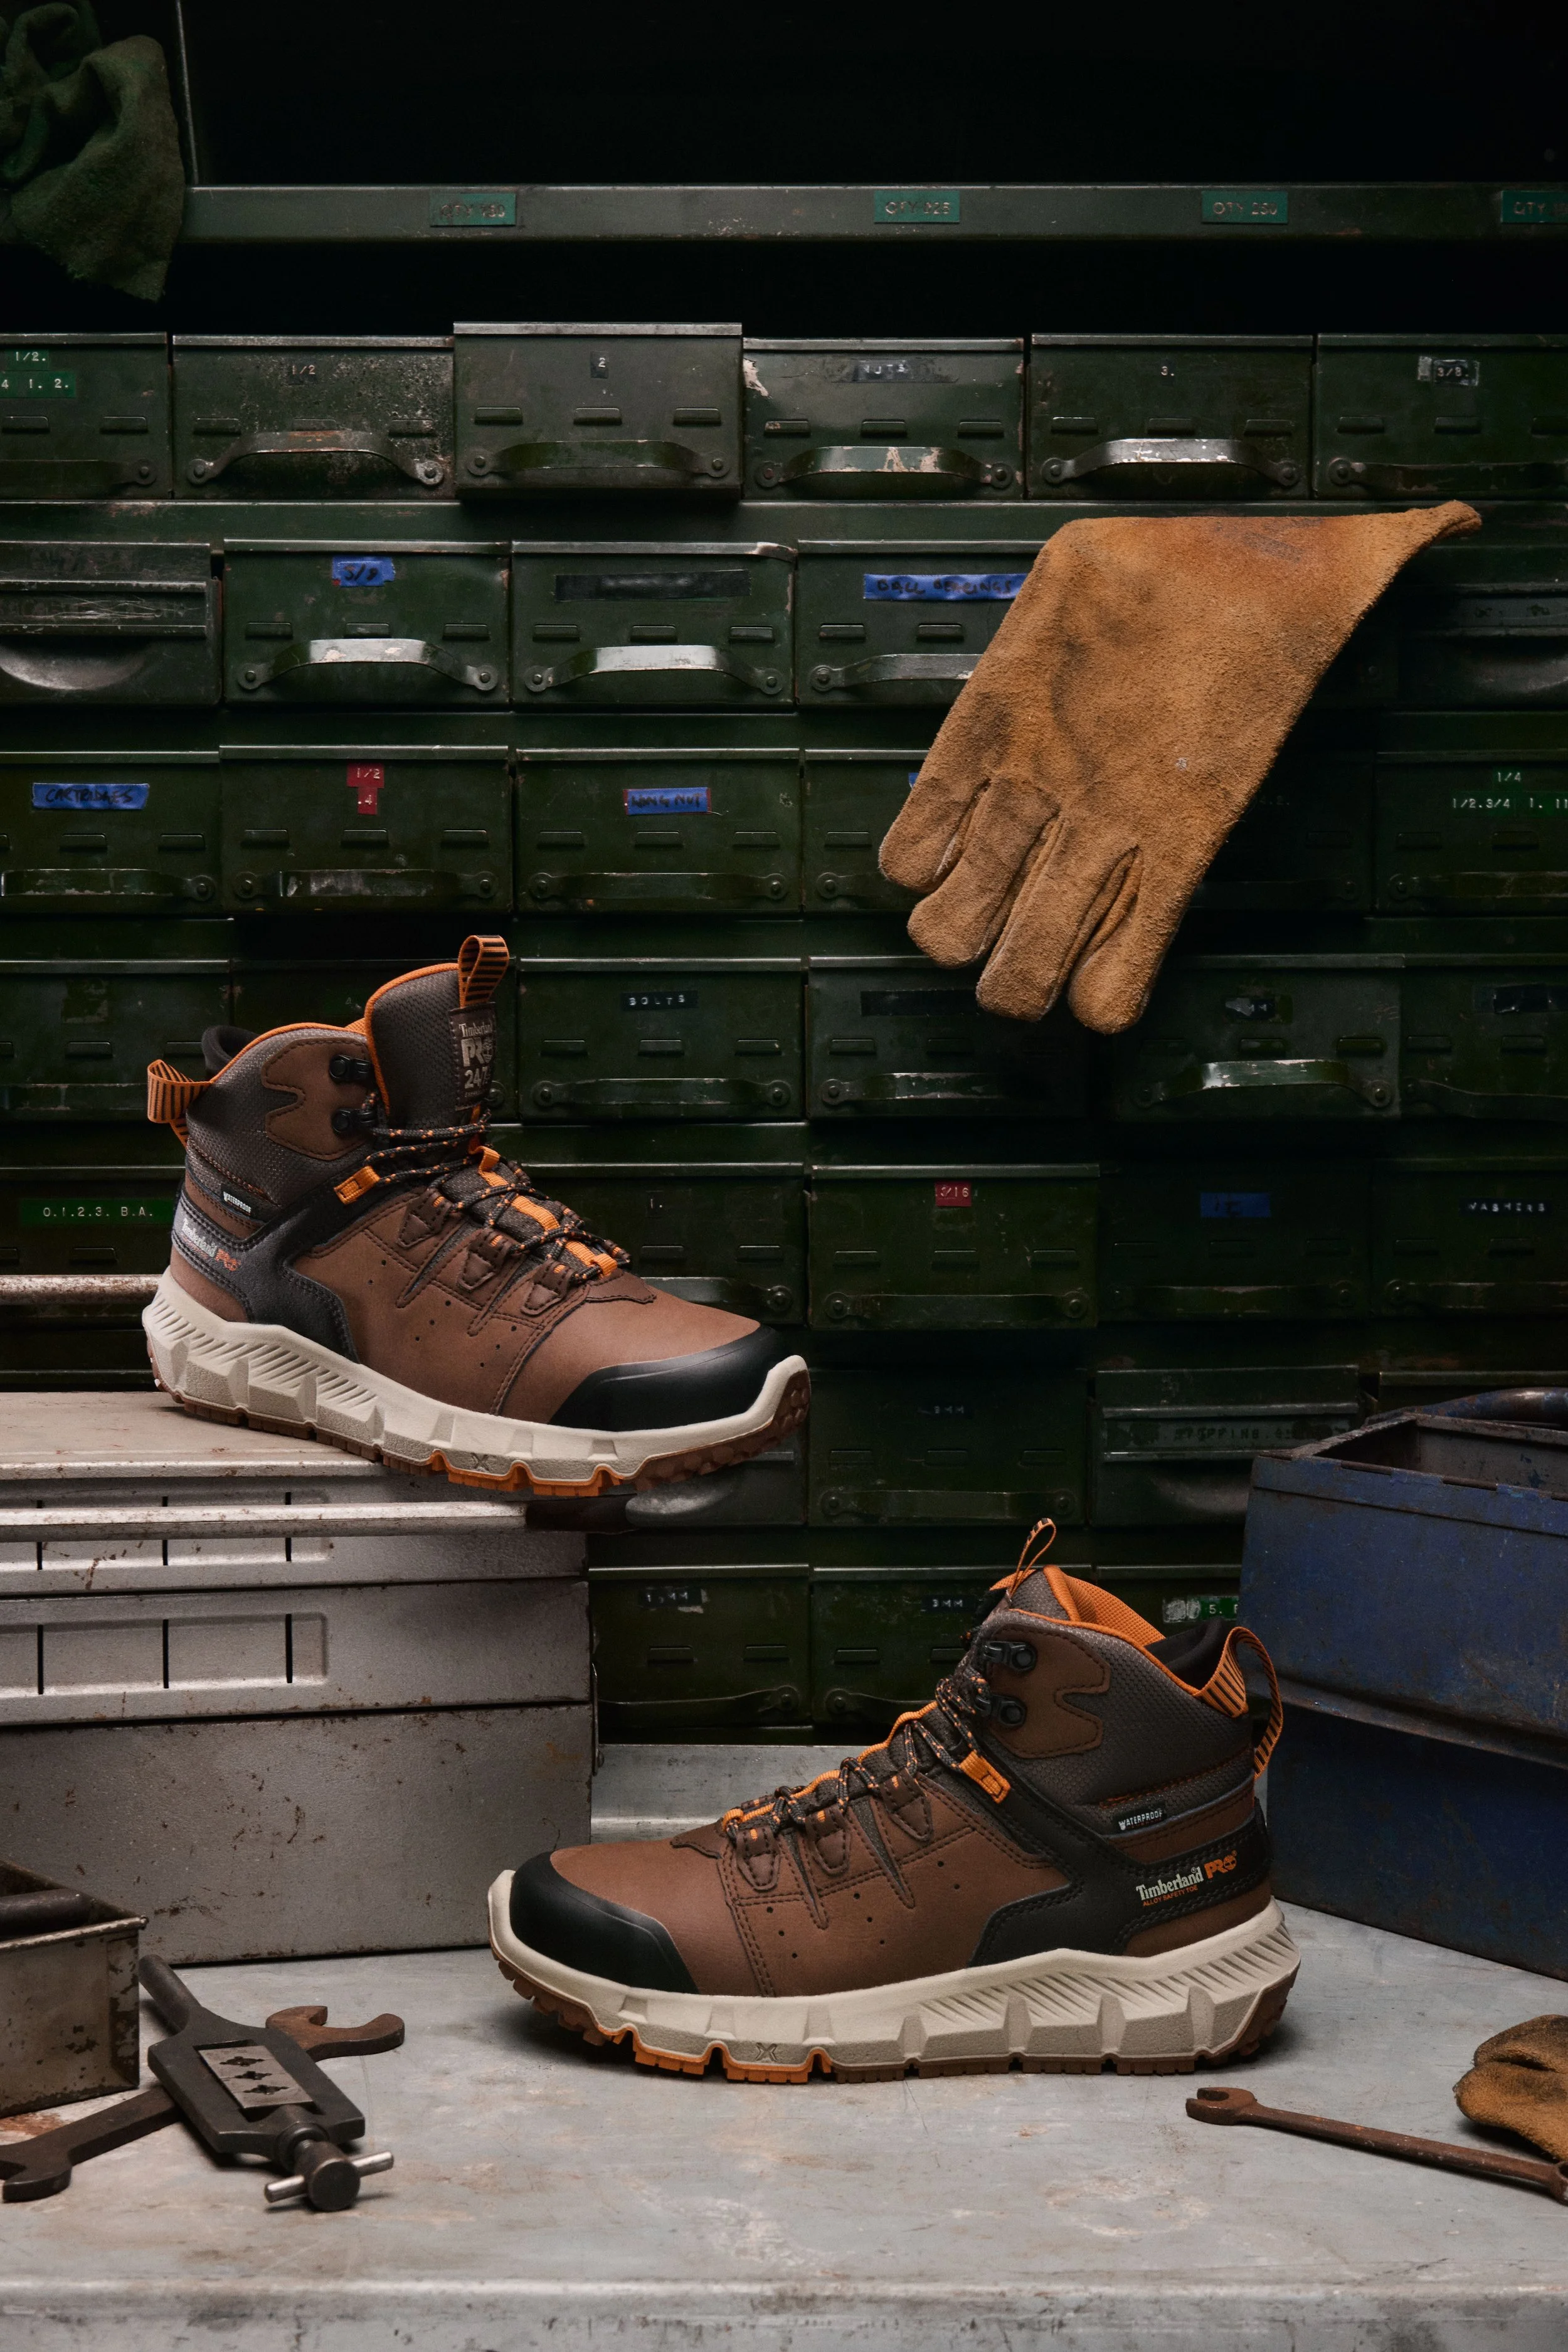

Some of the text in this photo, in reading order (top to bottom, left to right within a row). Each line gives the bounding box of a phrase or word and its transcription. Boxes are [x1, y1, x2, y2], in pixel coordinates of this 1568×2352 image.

[1251, 201, 1278, 215] 250
[15, 351, 46, 361] 1/2.
[598, 357, 606, 368] 2
[292, 365, 315, 375] 1/2
[1160, 366, 1175, 376] 3.
[357, 768, 380, 779] 1/2
[1496, 771, 1522, 783] 1/4
[674, 792, 702, 808] NUT
[1453, 798, 1511, 809] 1/2.3/4
[628, 995, 686, 1006] BOLTS
[120, 1206, 153, 1217] B.A.
[1468, 1202, 1545, 1212] WASHERS
[1118, 1810, 1163, 1831] WATERPROOF
[1136, 1867, 1204, 1900] Timberland
[1143, 1884, 1199, 1907] ALLOY SAFETY TOE
